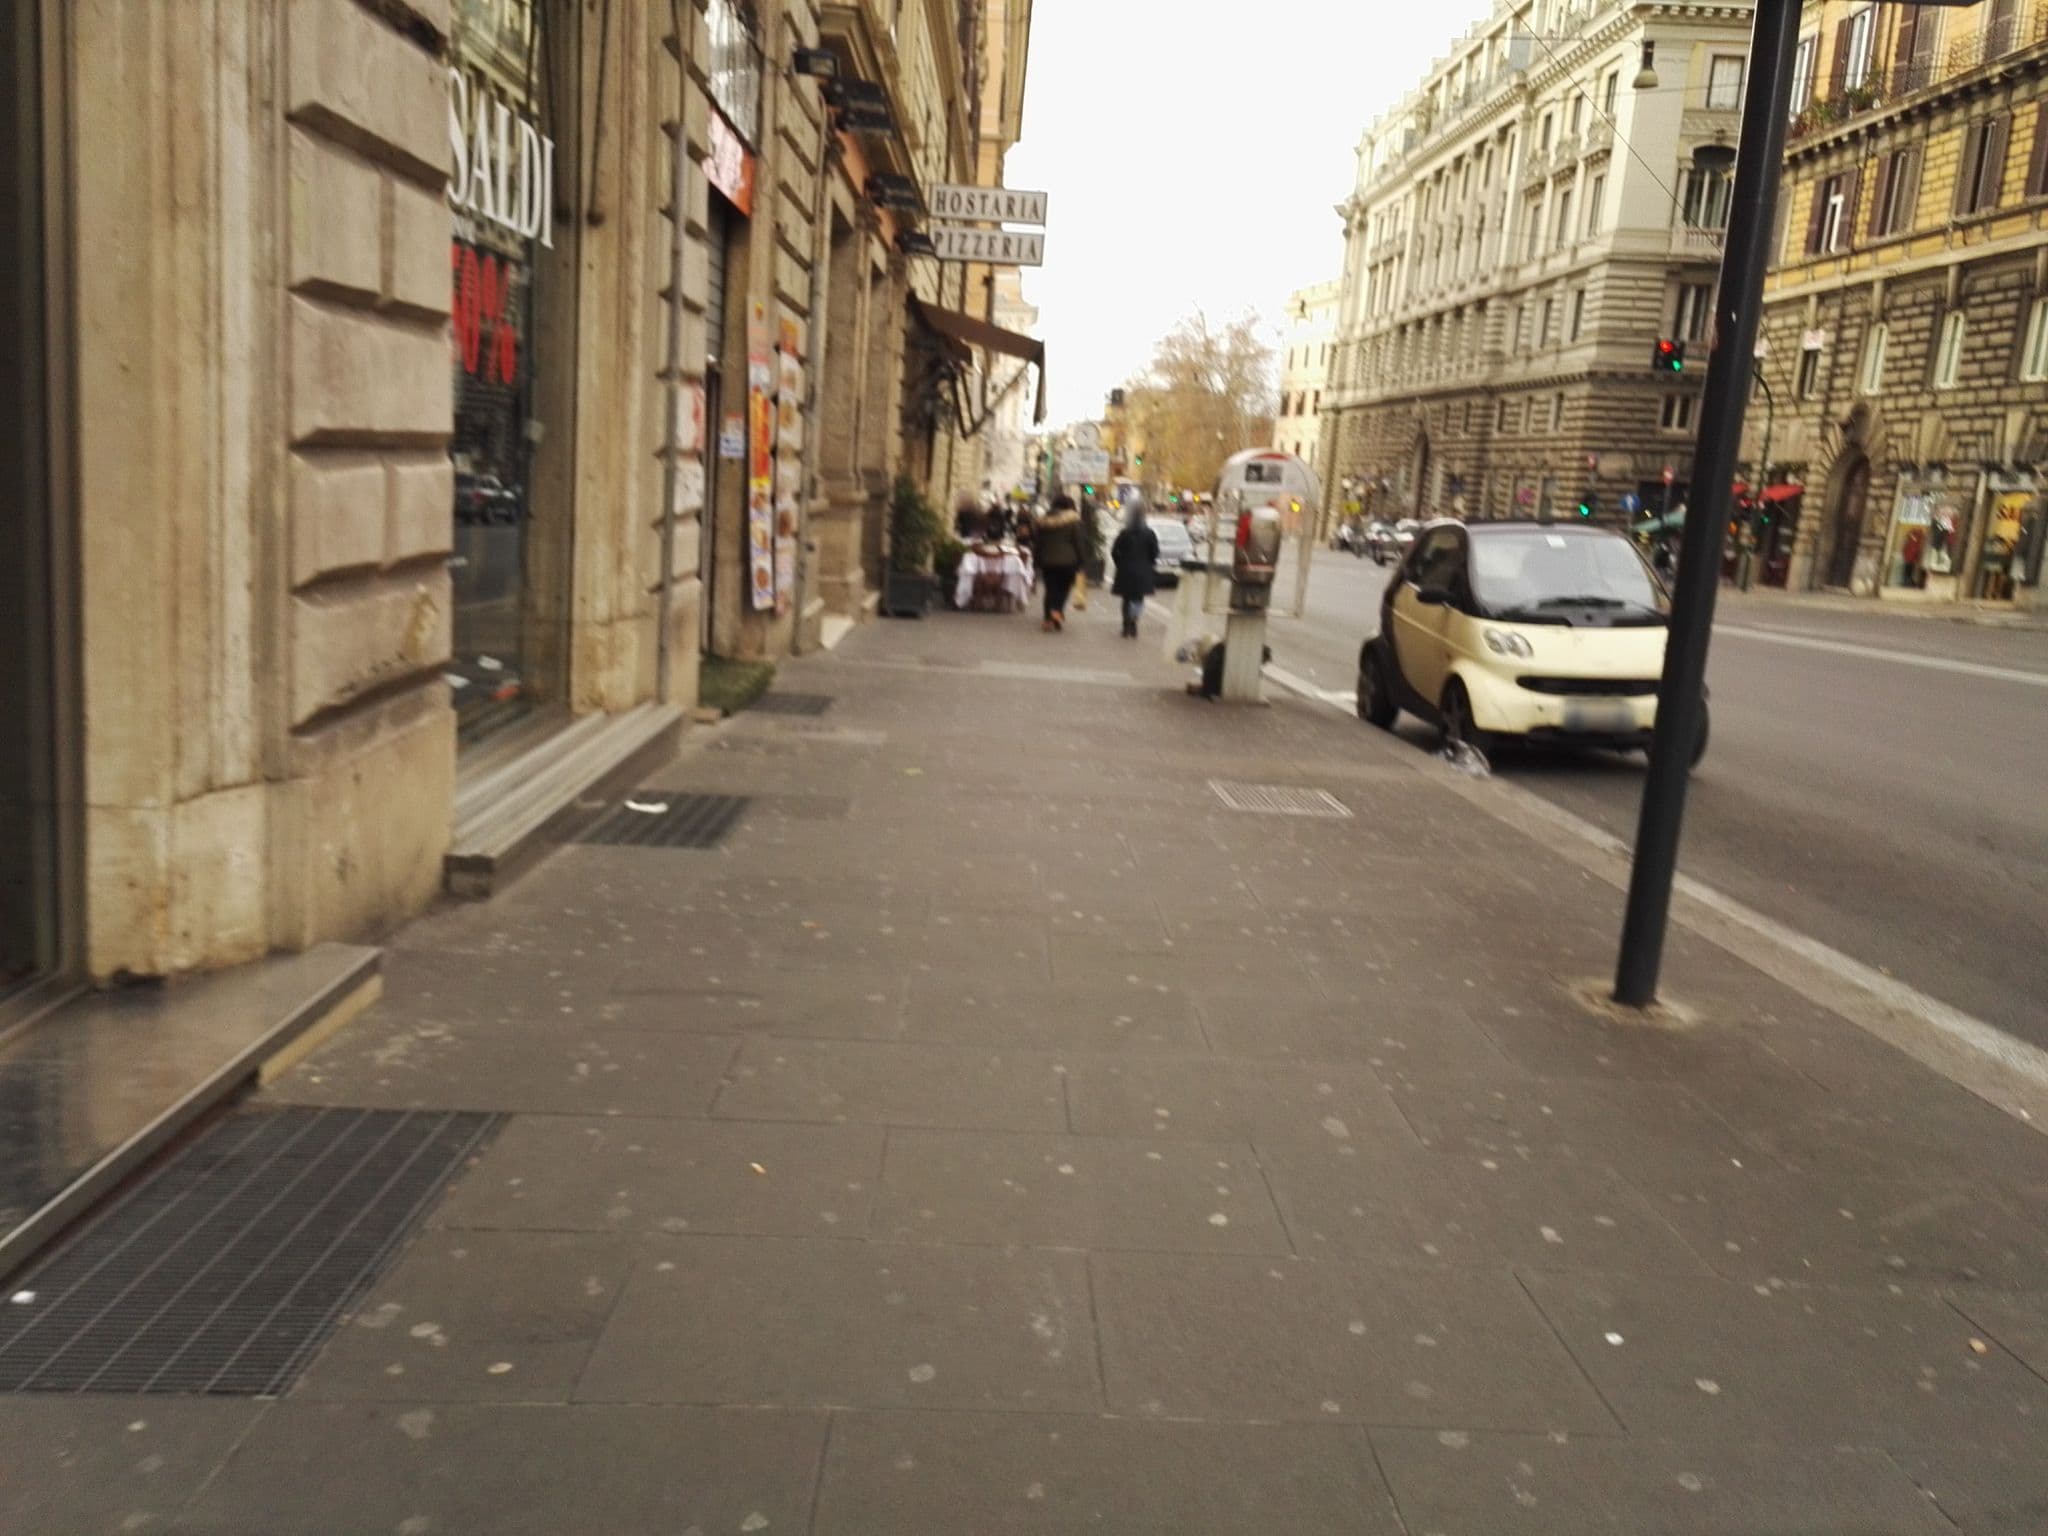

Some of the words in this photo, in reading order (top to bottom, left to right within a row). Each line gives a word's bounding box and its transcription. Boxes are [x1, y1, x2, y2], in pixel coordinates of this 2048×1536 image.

[447, 66, 555, 249] SALDI
[936, 191, 1040, 219] HOSTARIA
[934, 231, 1037, 261] PIZZERIA
